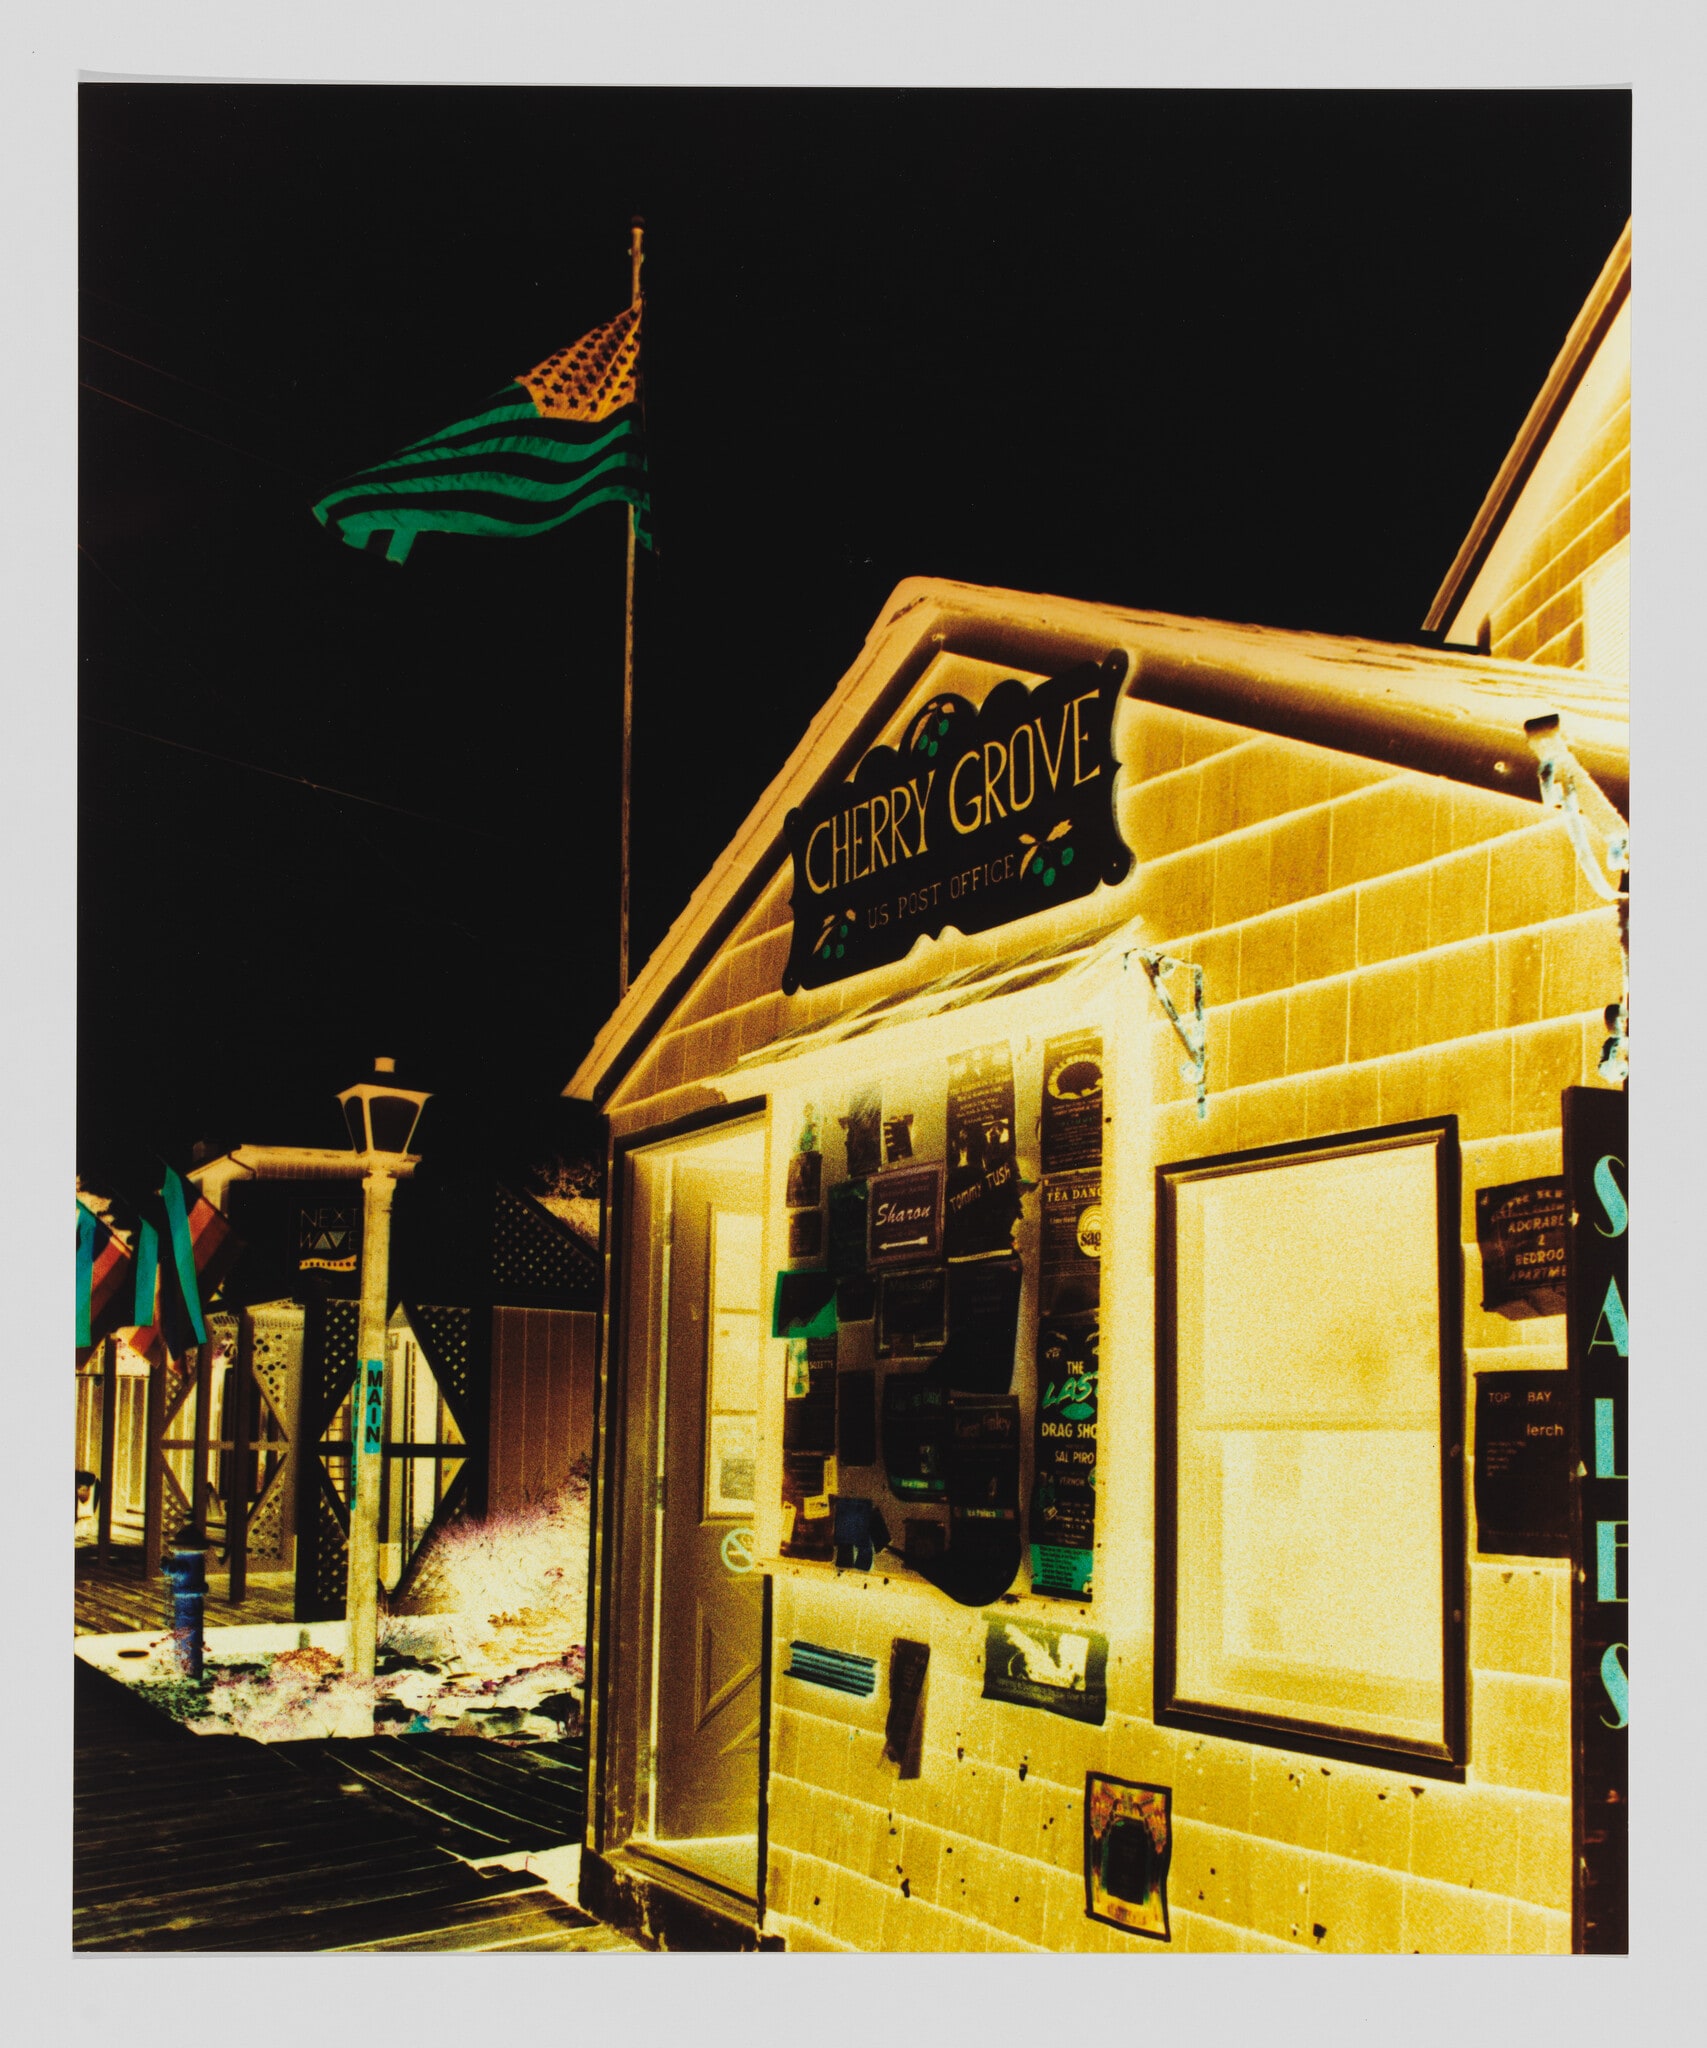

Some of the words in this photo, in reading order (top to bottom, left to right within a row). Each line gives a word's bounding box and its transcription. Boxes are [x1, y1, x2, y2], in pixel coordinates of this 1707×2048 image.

[805, 769, 937, 895] CHERRY
[948, 688, 1100, 835] GROVE
[867, 903, 889, 929] US
[898, 882, 941, 919] POST
[950, 854, 1015, 899] OFFICE
[985, 1162, 1013, 1190] TUSH
[1047, 1191, 1069, 1203] TEA
[299, 1207, 360, 1229] NEXT
[875, 1203, 931, 1226] Sharon
[298, 1231, 360, 1250] WAVE
[1066, 1361, 1085, 1375] THE
[366, 1370, 383, 1443] MAIN
[1488, 1392, 1512, 1403] TOP
[1527, 1391, 1552, 1403] BAY
[1042, 1422, 1073, 1438] DRAG
[1588, 1155, 1629, 1729] SALES
[1055, 1450, 1069, 1463] SAL
[1073, 1451, 1095, 1464] PIRO
